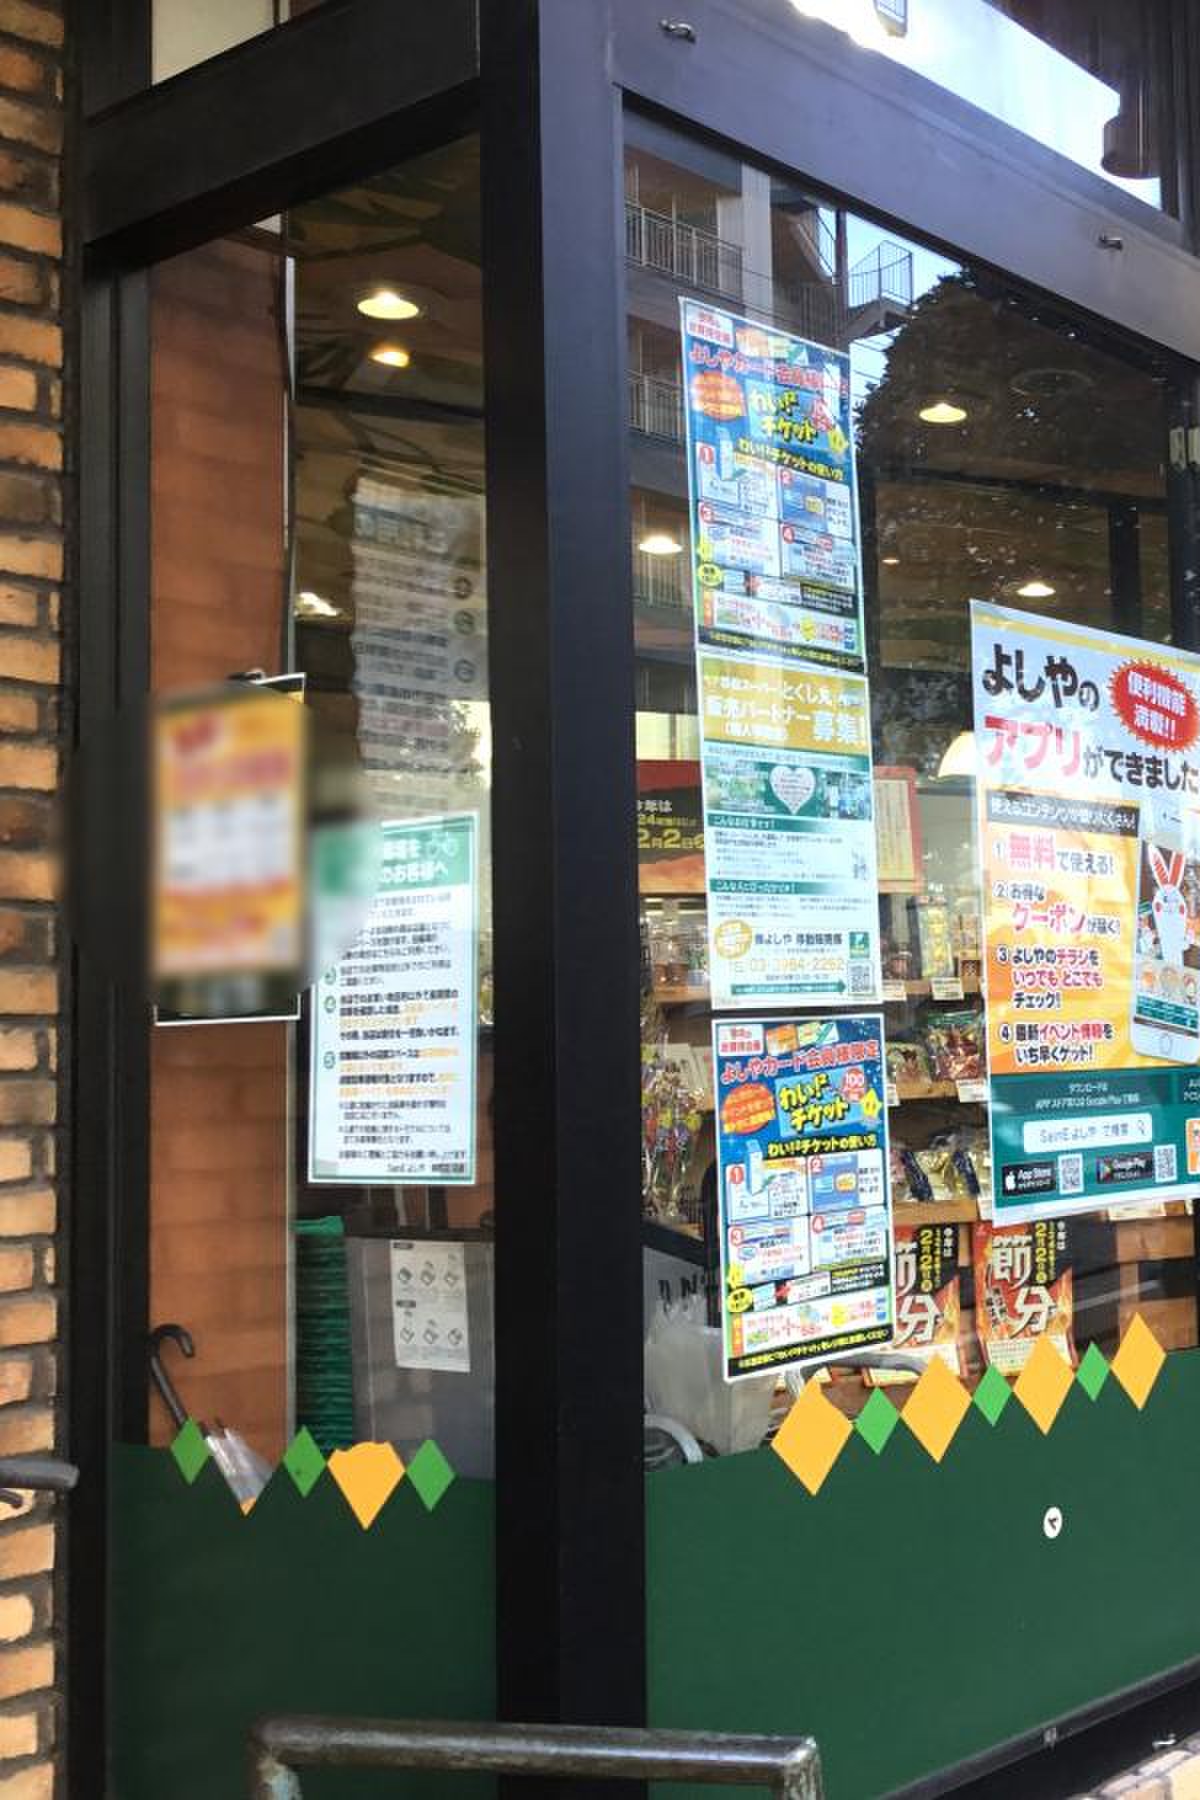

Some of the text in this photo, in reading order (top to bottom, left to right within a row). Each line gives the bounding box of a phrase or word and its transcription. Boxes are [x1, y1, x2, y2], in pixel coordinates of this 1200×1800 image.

[982, 644, 1100, 711] よしやの
[992, 1235, 1057, 1340] 節分
